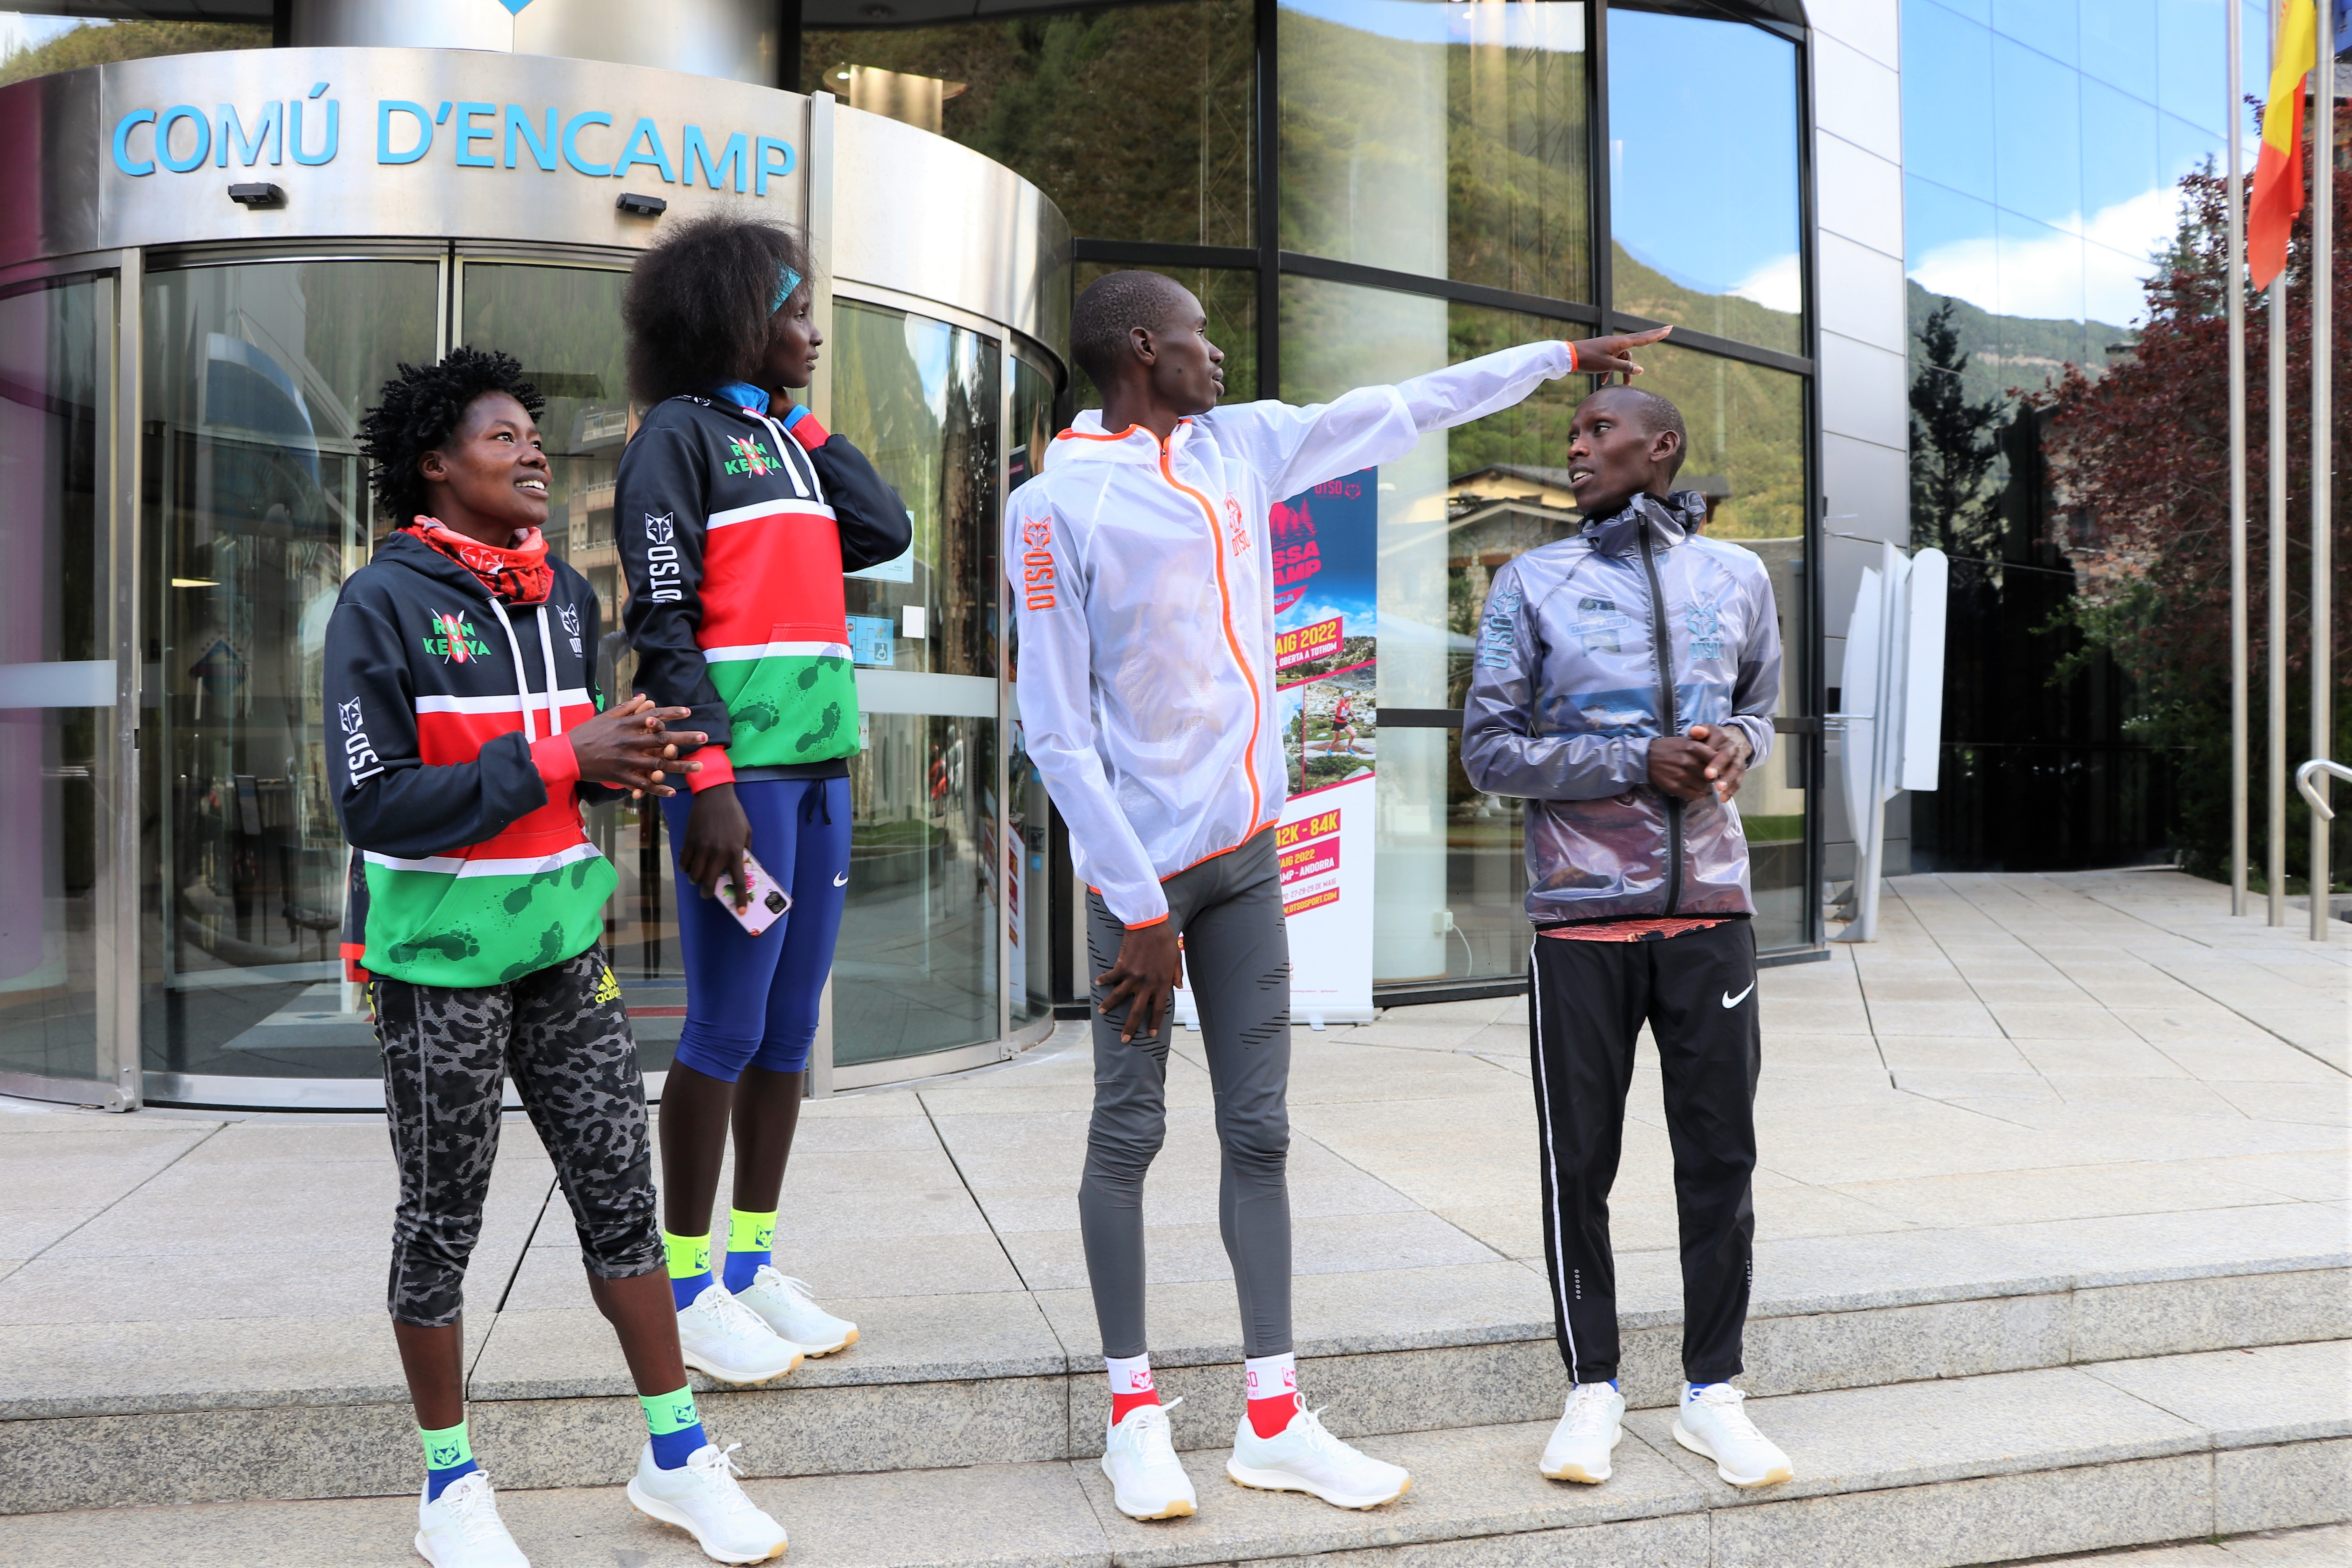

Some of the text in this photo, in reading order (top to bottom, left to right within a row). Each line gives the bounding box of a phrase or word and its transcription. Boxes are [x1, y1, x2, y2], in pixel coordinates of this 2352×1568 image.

[112, 82, 797, 196] COMÚ D'ENCAMP
[730, 443, 768, 457] RUN
[724, 456, 783, 475] KENYA
[1232, 529, 1250, 556] OTSO
[647, 546, 683, 600] OTSO
[1023, 552, 1056, 611] OTSO
[432, 618, 476, 637] RUN
[1300, 621, 1337, 649] 2022
[422, 637, 492, 655] KENYA
[1482, 616, 1513, 669] OTSO
[1690, 641, 1719, 659] OTSO
[1279, 652, 1304, 667] OBERTA
[1304, 650, 1310, 659] A
[1311, 641, 1338, 657] TOTHOM
[1310, 812, 1338, 836] 84K
[1295, 849, 1315, 864] 2022
[1299, 857, 1335, 877] ANDORRA
[1291, 885, 1314, 898] 27-28-29
[1315, 882, 1322, 890] DE
[1323, 878, 1337, 887] MAIG
